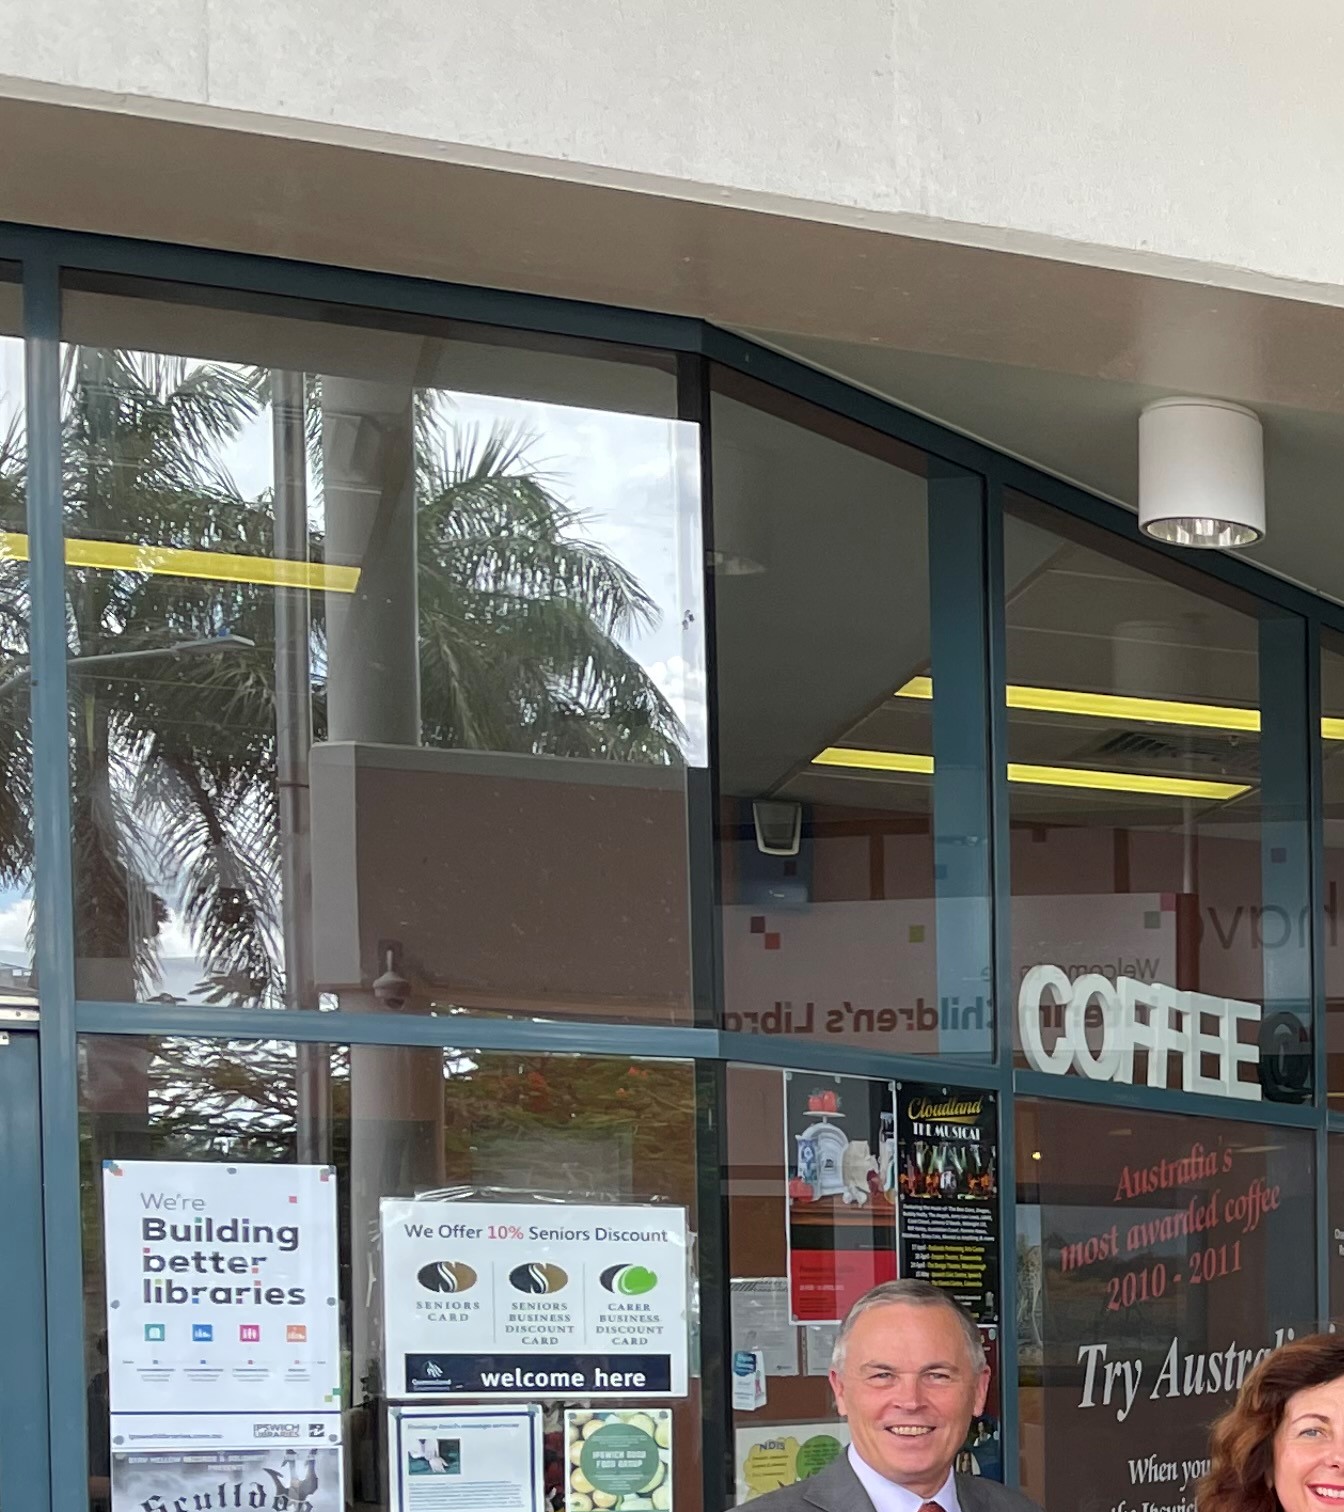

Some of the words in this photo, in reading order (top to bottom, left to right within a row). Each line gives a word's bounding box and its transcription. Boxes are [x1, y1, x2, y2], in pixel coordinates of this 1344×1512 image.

[1019, 964, 1262, 1101] COFFEE
[908, 1095, 982, 1121] Cloudland
[1113, 1135, 1233, 1201] Australia's
[140, 1192, 206, 1211] We're
[404, 1224, 433, 1239] We
[438, 1224, 483, 1240] Offer
[488, 1226, 524, 1240] 10%
[529, 1226, 590, 1241] Seniors
[596, 1227, 668, 1242] Discount
[1060, 1225, 1118, 1272] most
[1127, 1189, 1220, 1251] awarded
[1225, 1176, 1281, 1234] coffee
[142, 1217, 299, 1251] Building
[143, 1248, 267, 1274] better
[1104, 1263, 1166, 1311] 2010
[1189, 1241, 1242, 1284] 2011
[143, 1278, 305, 1305] libraries
[416, 1301, 480, 1310] SENIORS
[512, 1302, 568, 1311] SENIORS
[608, 1303, 650, 1312] CARER
[428, 1313, 468, 1322] CARD
[509, 1314, 571, 1322] BUSINESS
[600, 1314, 660, 1323] BUSINESS
[505, 1325, 574, 1334] DISCOUNT
[596, 1326, 663, 1334] DISCOUNT
[522, 1336, 558, 1345] CARD
[612, 1337, 648, 1346] CARD
[481, 1368, 584, 1387] welcome
[596, 1368, 646, 1387] here
[1077, 1343, 1143, 1421] Try
[1128, 1454, 1178, 1484] When
